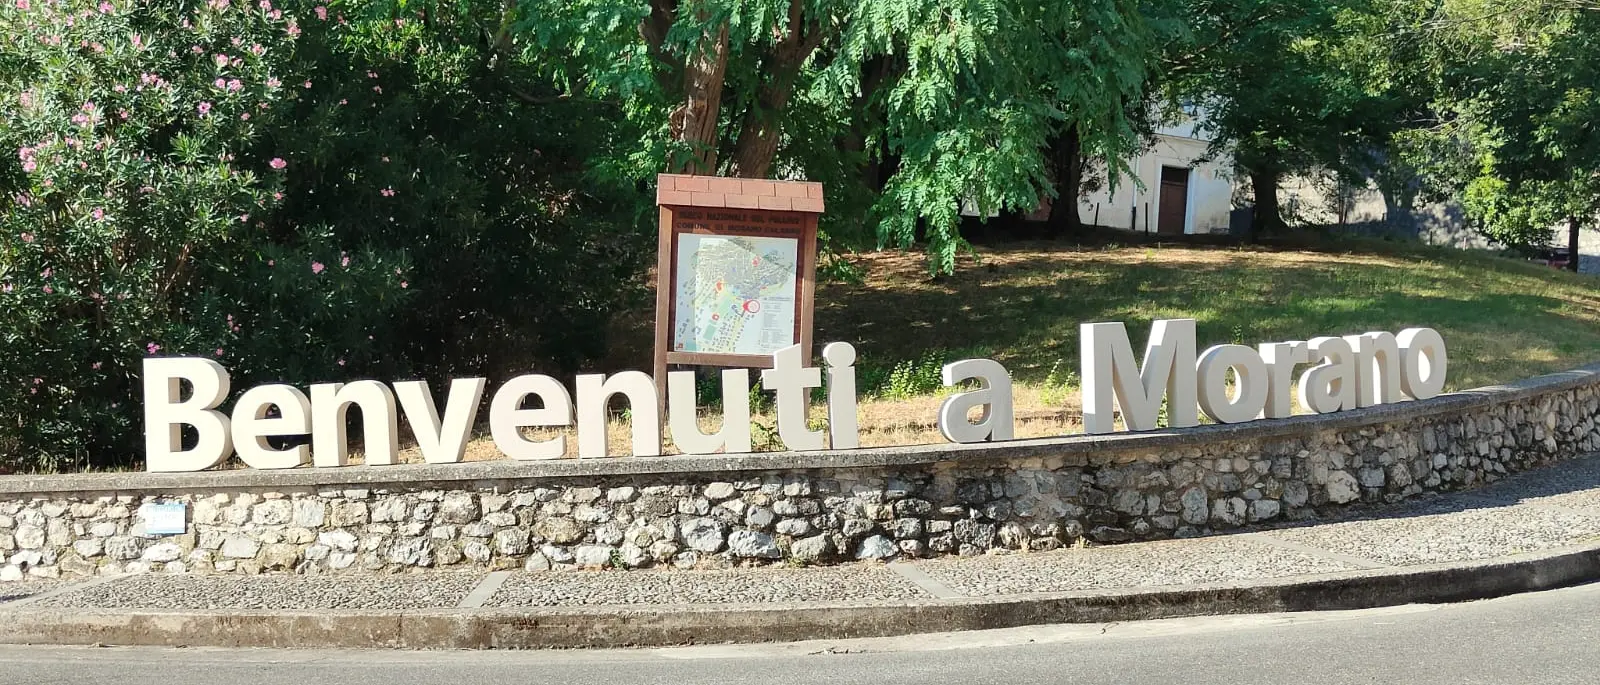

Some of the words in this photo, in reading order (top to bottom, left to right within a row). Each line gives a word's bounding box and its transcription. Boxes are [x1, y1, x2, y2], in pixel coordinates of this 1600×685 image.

[142, 342, 858, 472] Benvenuti
[938, 358, 1014, 443] a
[1080, 318, 1448, 434] Morano
